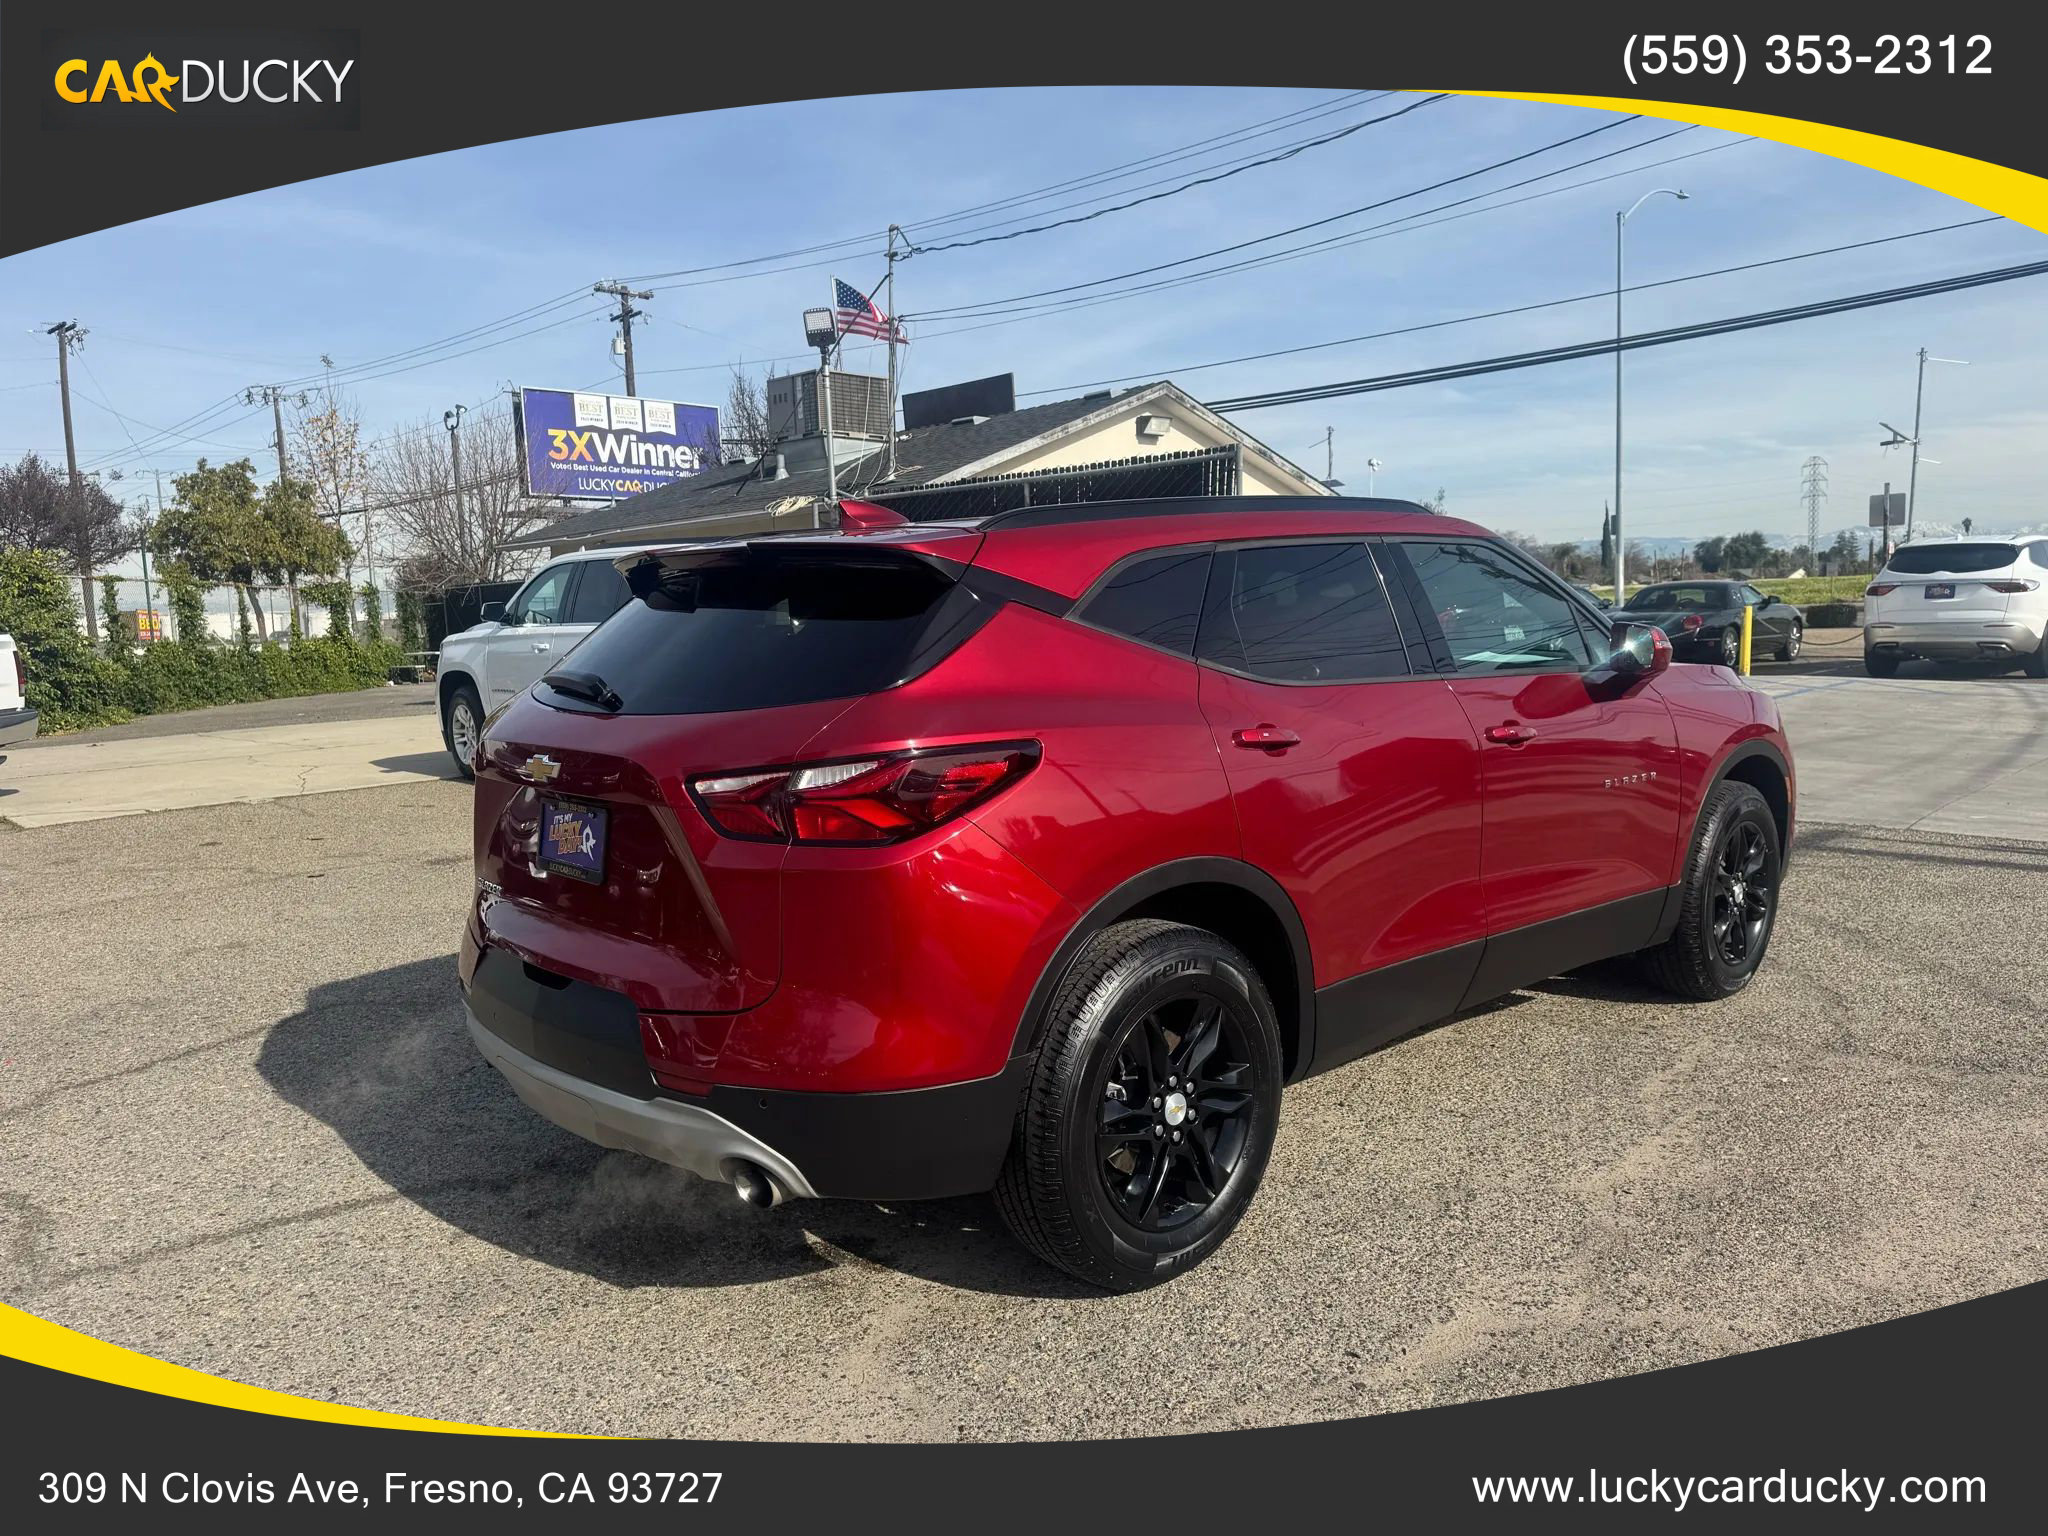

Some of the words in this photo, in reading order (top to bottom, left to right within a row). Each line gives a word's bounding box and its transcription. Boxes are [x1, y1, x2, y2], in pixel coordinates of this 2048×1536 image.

[579, 402, 603, 414] BEST
[615, 406, 638, 417] BEST
[649, 409, 671, 420] BEST
[551, 461, 572, 471] Voted
[573, 463, 588, 471] Best
[590, 464, 607, 472] Used
[608, 465, 620, 473] Car
[621, 466, 642, 475] Dealer
[651, 468, 674, 477] Central
[1604, 771, 1657, 789] BLAZER
[564, 813, 573, 823] MY
[548, 820, 583, 841] LUCKY
